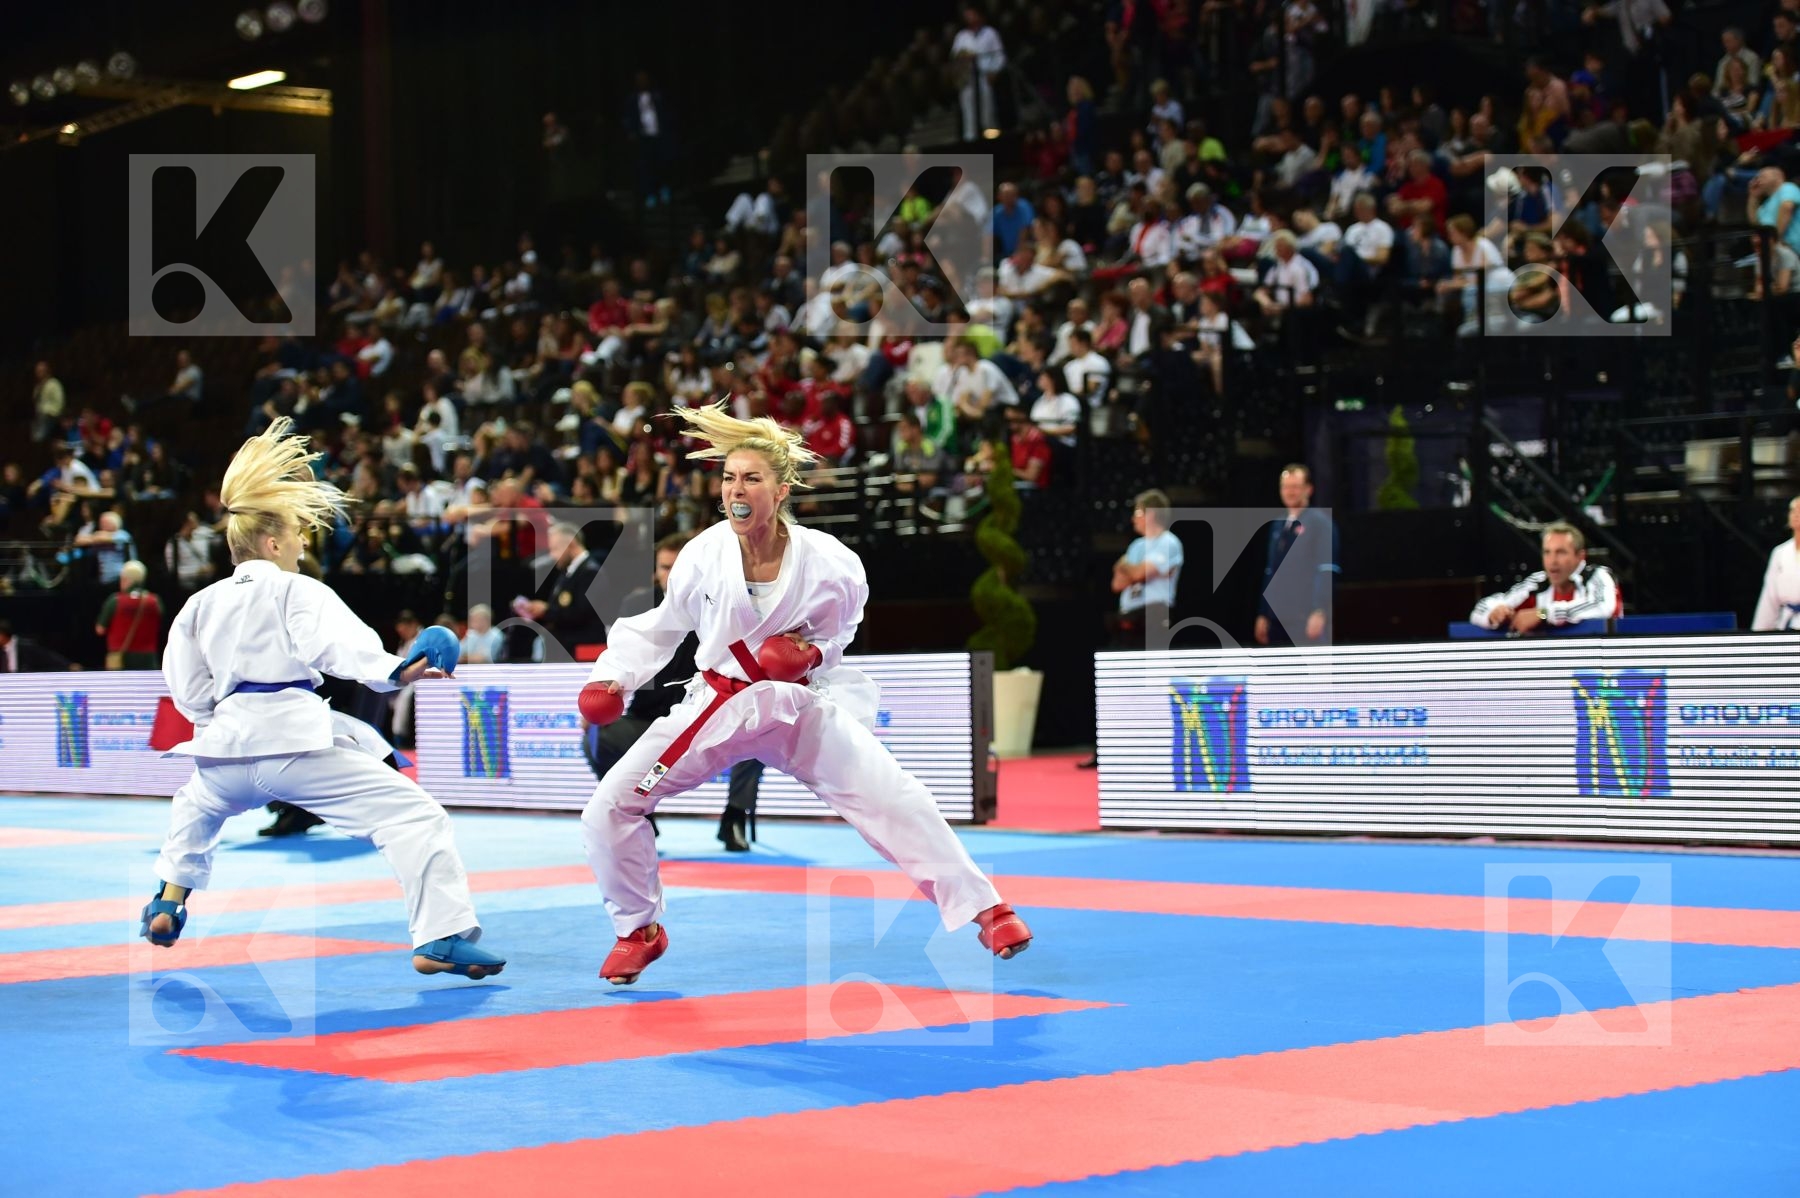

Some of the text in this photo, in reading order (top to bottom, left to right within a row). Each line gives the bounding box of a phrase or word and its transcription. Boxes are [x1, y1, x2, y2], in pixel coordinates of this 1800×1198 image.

[1258, 705, 1428, 727] GROUPE MDS
[1680, 704, 1800, 724] GROUPE
